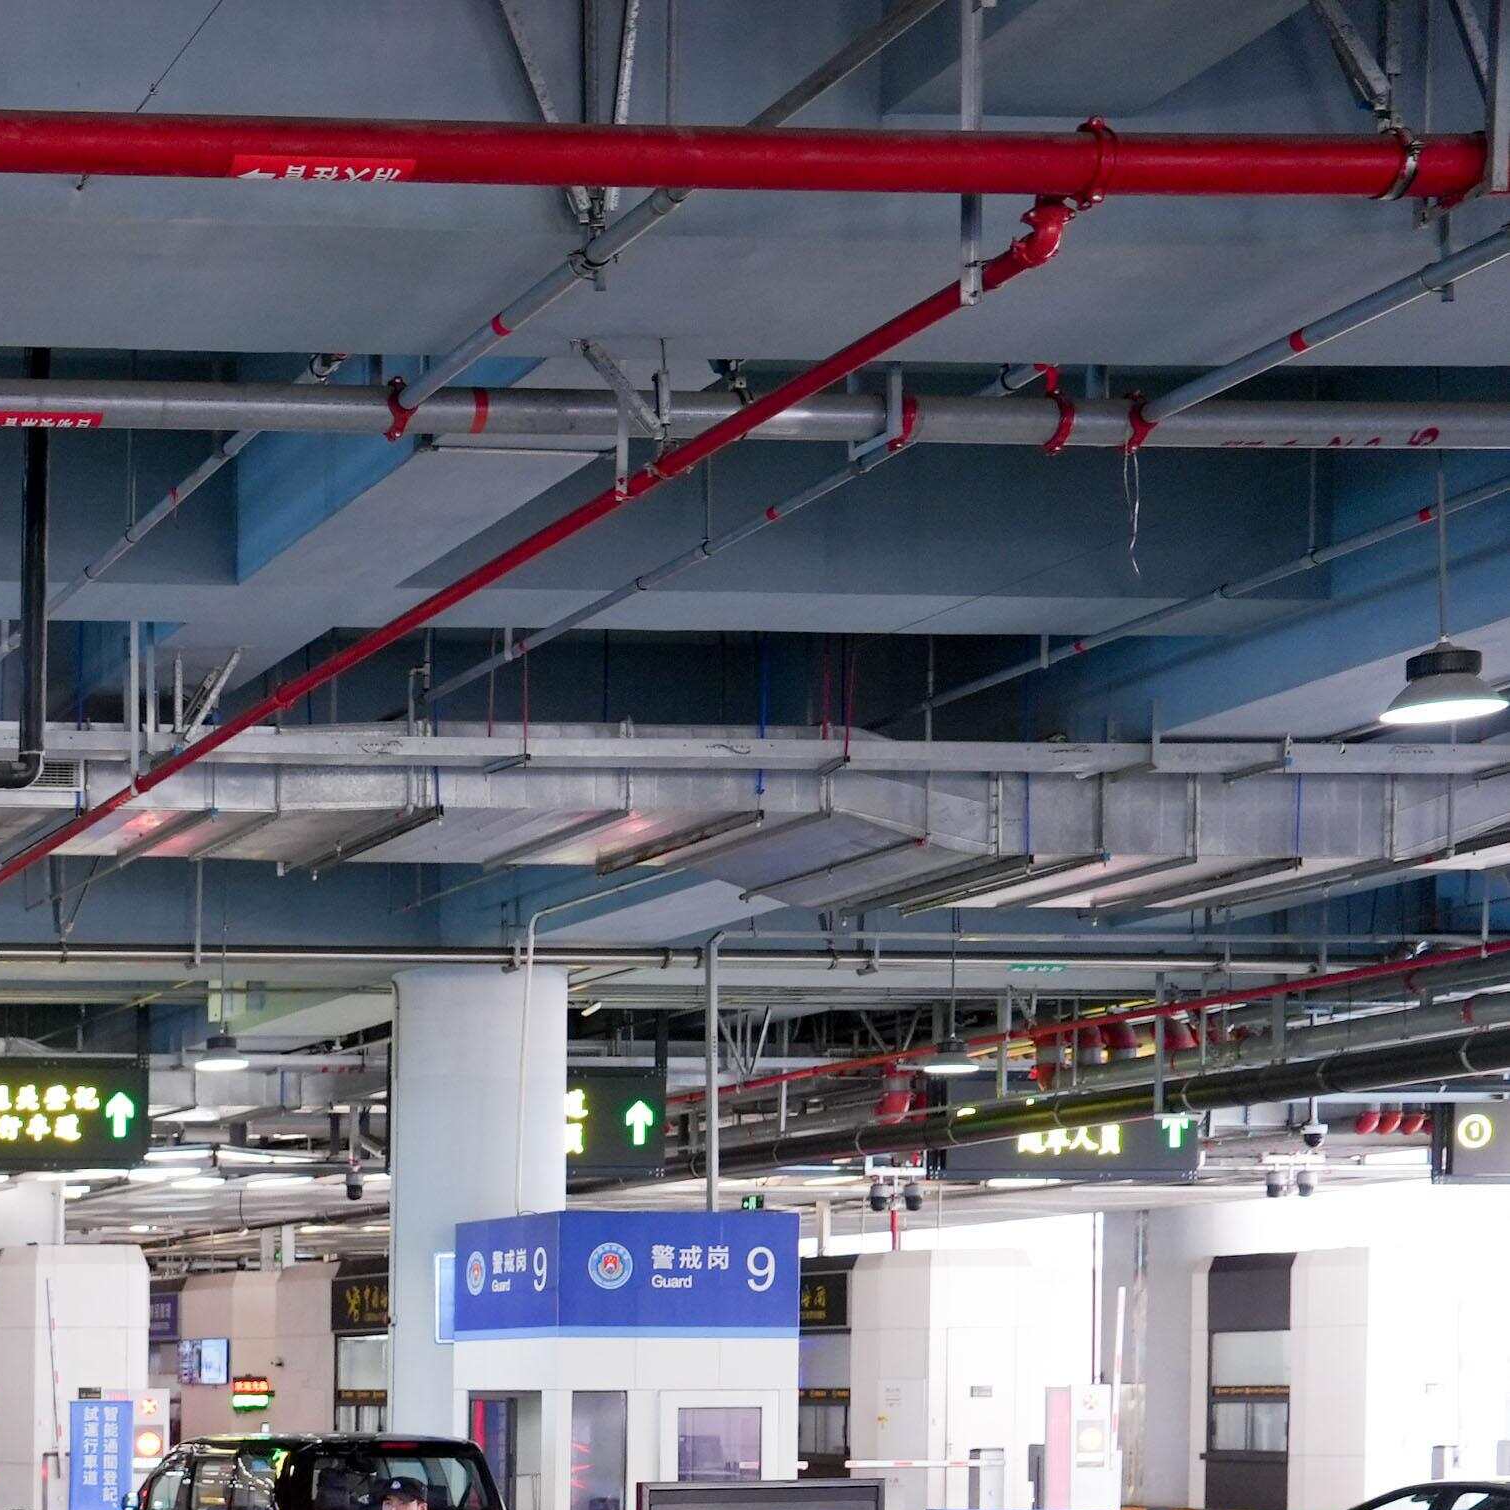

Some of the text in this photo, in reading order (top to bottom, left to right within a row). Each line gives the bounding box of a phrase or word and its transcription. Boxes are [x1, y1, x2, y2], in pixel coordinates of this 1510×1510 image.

[492, 1246, 548, 1292] 警戒岗 9
[651, 1244, 776, 1293] 警戒岗 9
[651, 1274, 692, 1290] Guard
